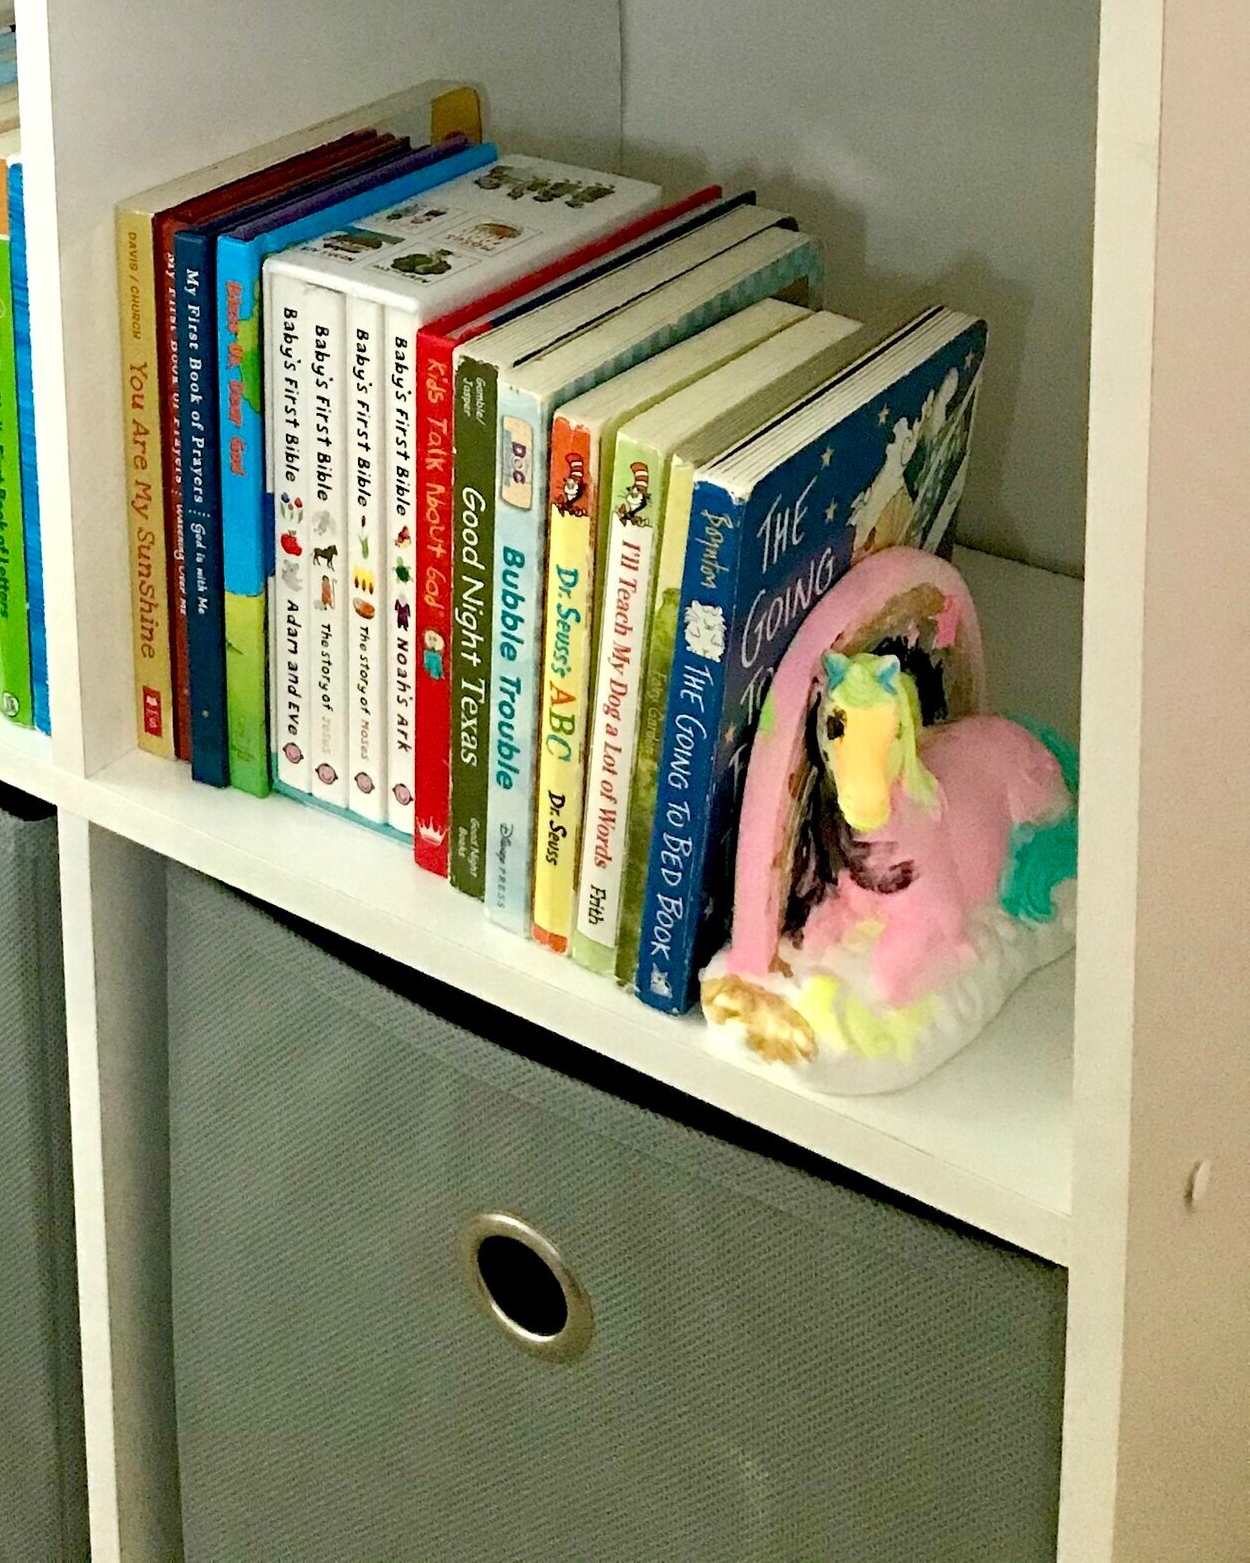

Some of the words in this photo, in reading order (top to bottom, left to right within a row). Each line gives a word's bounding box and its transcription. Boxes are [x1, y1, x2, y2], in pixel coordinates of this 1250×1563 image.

[128, 231, 138, 271] DAVIS
[186, 268, 199, 297] My
[128, 285, 141, 341] CHURCH
[187, 302, 199, 351] First
[280, 307, 301, 371] Baby's
[312, 324, 334, 390] Baby's
[353, 328, 373, 393] Baby's
[129, 361, 148, 409] You
[188, 358, 202, 404] Book
[391, 336, 412, 402] Baby's
[426, 358, 449, 404] Kids
[192, 411, 204, 431] of
[284, 378, 300, 428] First
[315, 396, 332, 447] First
[462, 378, 472, 417] Jasper
[475, 376, 486, 426] Gamble/
[132, 420, 149, 471] Are
[356, 401, 371, 452] First
[395, 409, 411, 461] First
[426, 416, 449, 472] Talk
[190, 436, 205, 503] Prayers
[285, 433, 300, 482] Bible
[316, 451, 332, 502] Bible
[357, 456, 371, 508] Bible
[131, 481, 152, 521] My
[396, 465, 411, 516] Bible
[191, 523, 206, 553] God
[425, 481, 446, 558] About
[462, 487, 486, 570] Good
[756, 477, 819, 575] THE
[621, 540, 641, 571] I'll
[700, 509, 733, 588] Boynton
[137, 527, 160, 660] SunShine
[195, 566, 207, 595] with
[424, 566, 446, 616] God
[500, 545, 526, 662] Bubble
[556, 564, 579, 597] Dr.
[198, 599, 208, 615] Me
[287, 600, 302, 655] Adam
[454, 574, 485, 667] Night
[615, 575, 638, 637] Teach
[739, 546, 837, 669] GOING
[321, 623, 332, 651] The
[360, 626, 371, 652] The
[552, 601, 581, 679] Seuss's
[612, 639, 632, 677] My
[290, 662, 302, 699] and
[317, 654, 330, 692] story
[357, 655, 370, 695] story
[396, 637, 413, 707] Noah's
[679, 662, 714, 715] THE
[288, 702, 300, 736] Eve
[322, 692, 333, 712] of
[360, 696, 371, 716] of
[460, 678, 486, 768] Texas
[546, 680, 576, 762] ABC
[602, 678, 628, 722] Dog
[321, 715, 332, 756] Jesus
[360, 719, 371, 761] Moses
[396, 716, 410, 752] Ark
[496, 676, 522, 790] Trouble
[607, 726, 619, 737] a
[667, 713, 710, 790] GOING
[602, 741, 624, 777] Lot
[548, 790, 566, 817] Dr.
[601, 782, 618, 804] of
[666, 800, 692, 829] TO
[545, 821, 567, 867] Seuss
[595, 806, 618, 870] Words
[660, 832, 693, 887] BED
[588, 884, 607, 925] Frith
[650, 892, 684, 962] BOOK
